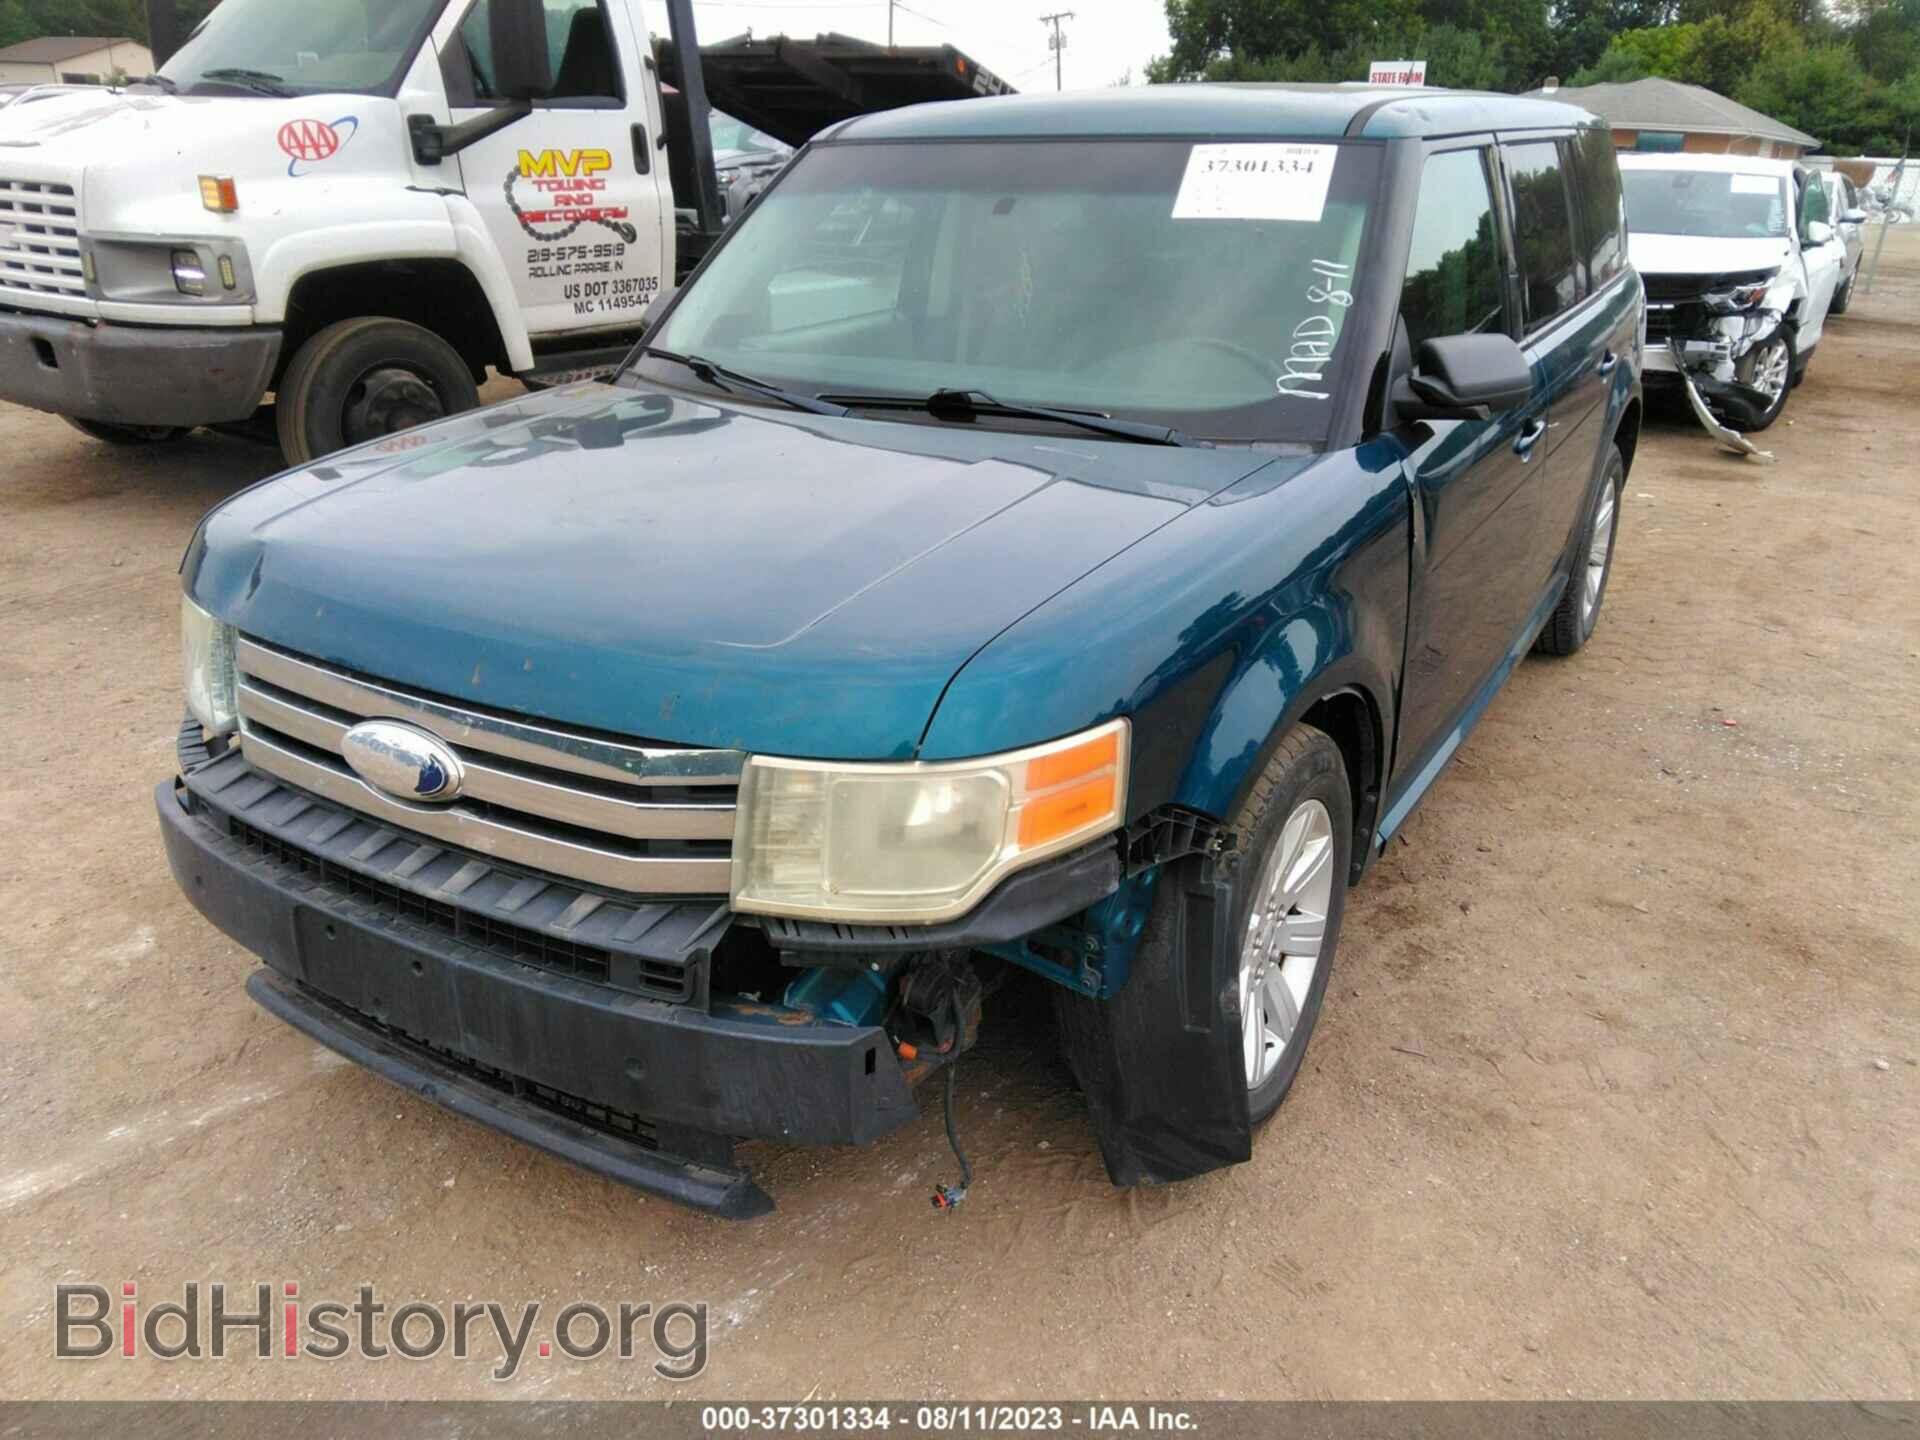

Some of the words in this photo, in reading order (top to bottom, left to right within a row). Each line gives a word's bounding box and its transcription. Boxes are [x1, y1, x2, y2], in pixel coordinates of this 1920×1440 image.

[1372, 72, 1397, 84] STATE
[282, 119, 337, 160] AAA
[517, 149, 612, 177] MVP
[1201, 159, 1314, 174] 37301334
[532, 178, 606, 192] TOWING
[554, 193, 594, 206] AND
[527, 243, 625, 263] 219-575-9519
[528, 264, 572, 279] ROLLING
[564, 284, 580, 299] US
[584, 281, 608, 297] DOT
[612, 277, 659, 294] 3367035
[574, 301, 594, 314] MC
[598, 294, 650, 311] 1149544
